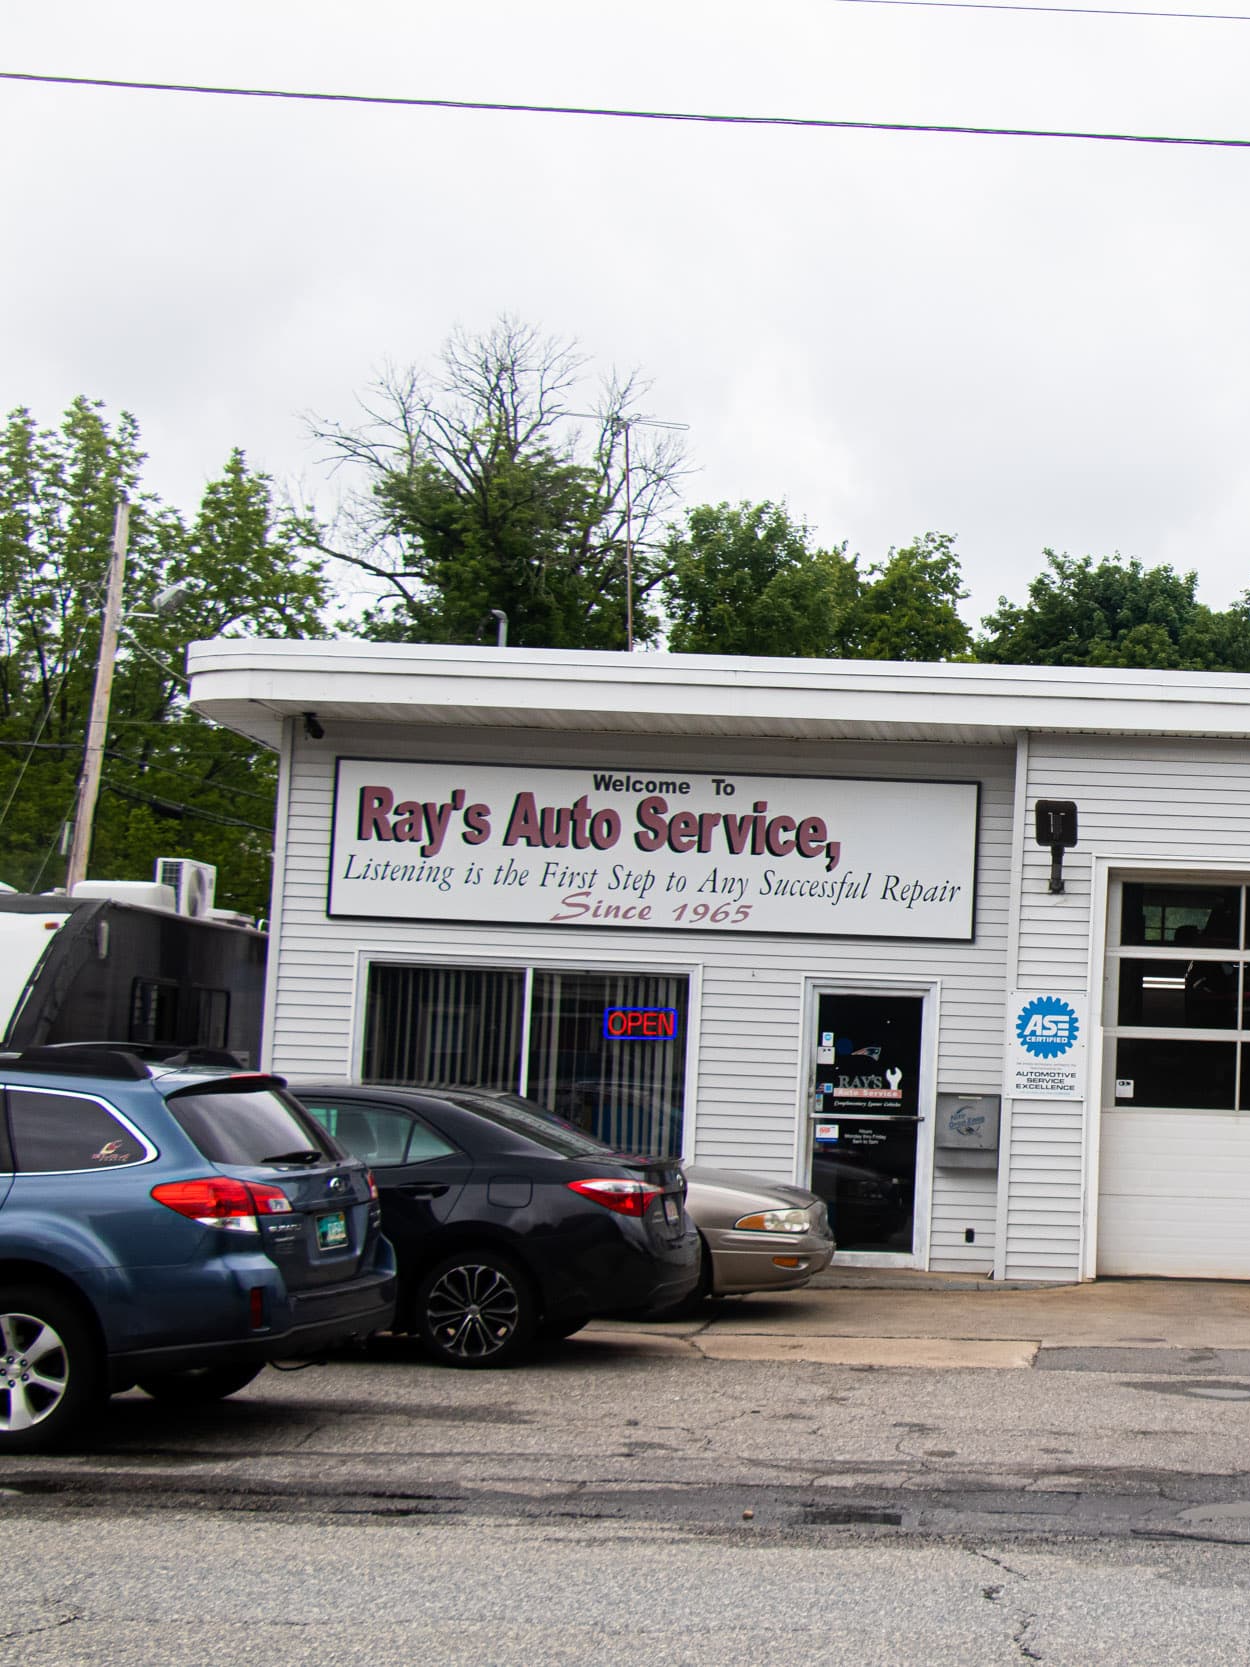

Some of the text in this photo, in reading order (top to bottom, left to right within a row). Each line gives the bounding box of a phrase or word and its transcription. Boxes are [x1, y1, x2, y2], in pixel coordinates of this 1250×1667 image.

[593, 774, 736, 796] Welcome To
[357, 785, 842, 872] Ray's Auto Service,
[343, 854, 961, 909] Listening is the First Step to Any Successful Repair
[549, 891, 753, 924] Since 1965
[608, 1011, 674, 1035] OPEN
[1023, 1014, 1070, 1036] ASE
[838, 1075, 883, 1089] RAY'S
[1016, 1071, 1077, 1079] AUTOMOTIVE
[839, 1088, 899, 1098] Auto Service
